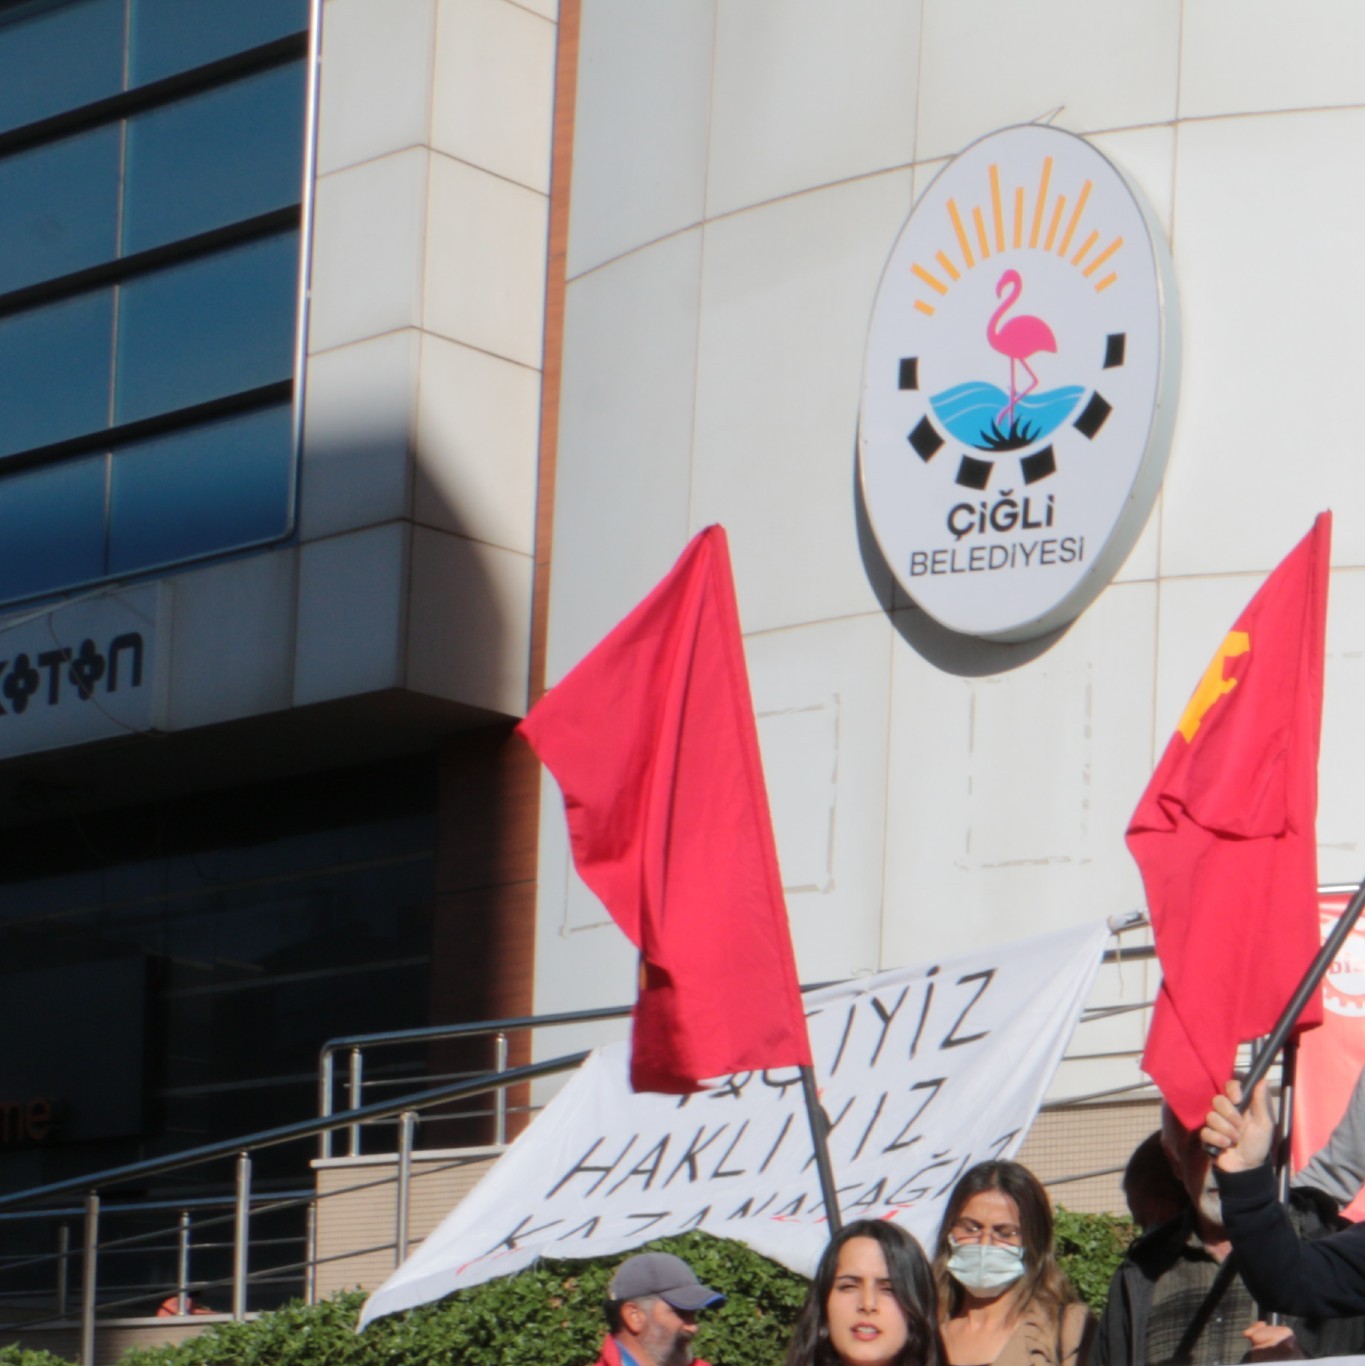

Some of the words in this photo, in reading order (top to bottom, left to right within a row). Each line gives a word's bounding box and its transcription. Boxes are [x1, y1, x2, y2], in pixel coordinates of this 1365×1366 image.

[947, 488, 1055, 541] ÇİĞLİ
[909, 536, 1085, 576] BELEDİYESİ
[0, 631, 143, 716] OTON
